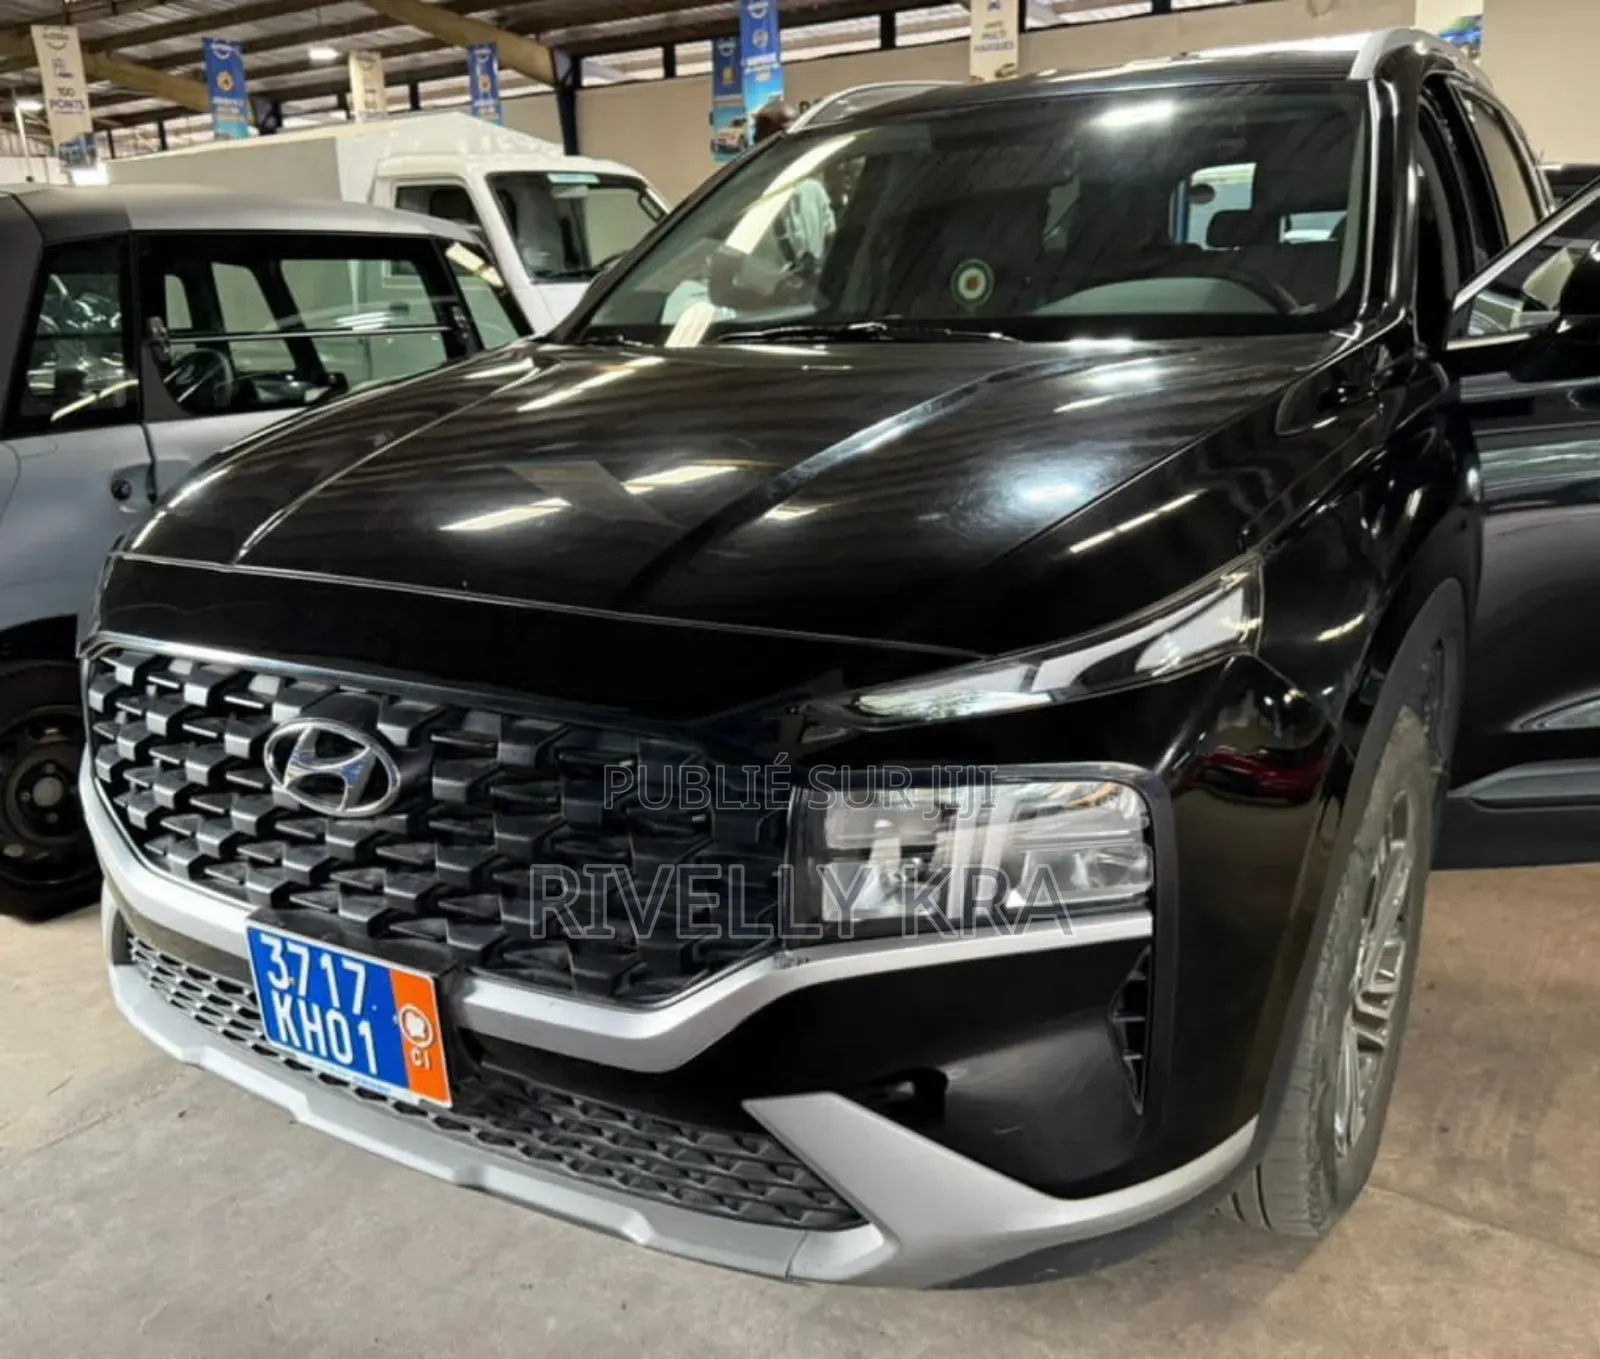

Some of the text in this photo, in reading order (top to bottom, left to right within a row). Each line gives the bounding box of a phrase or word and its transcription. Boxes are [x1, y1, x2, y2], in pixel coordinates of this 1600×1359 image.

[259, 934, 366, 1016] 3717
[271, 990, 377, 1076] KH01
[411, 1048, 431, 1070] CI
